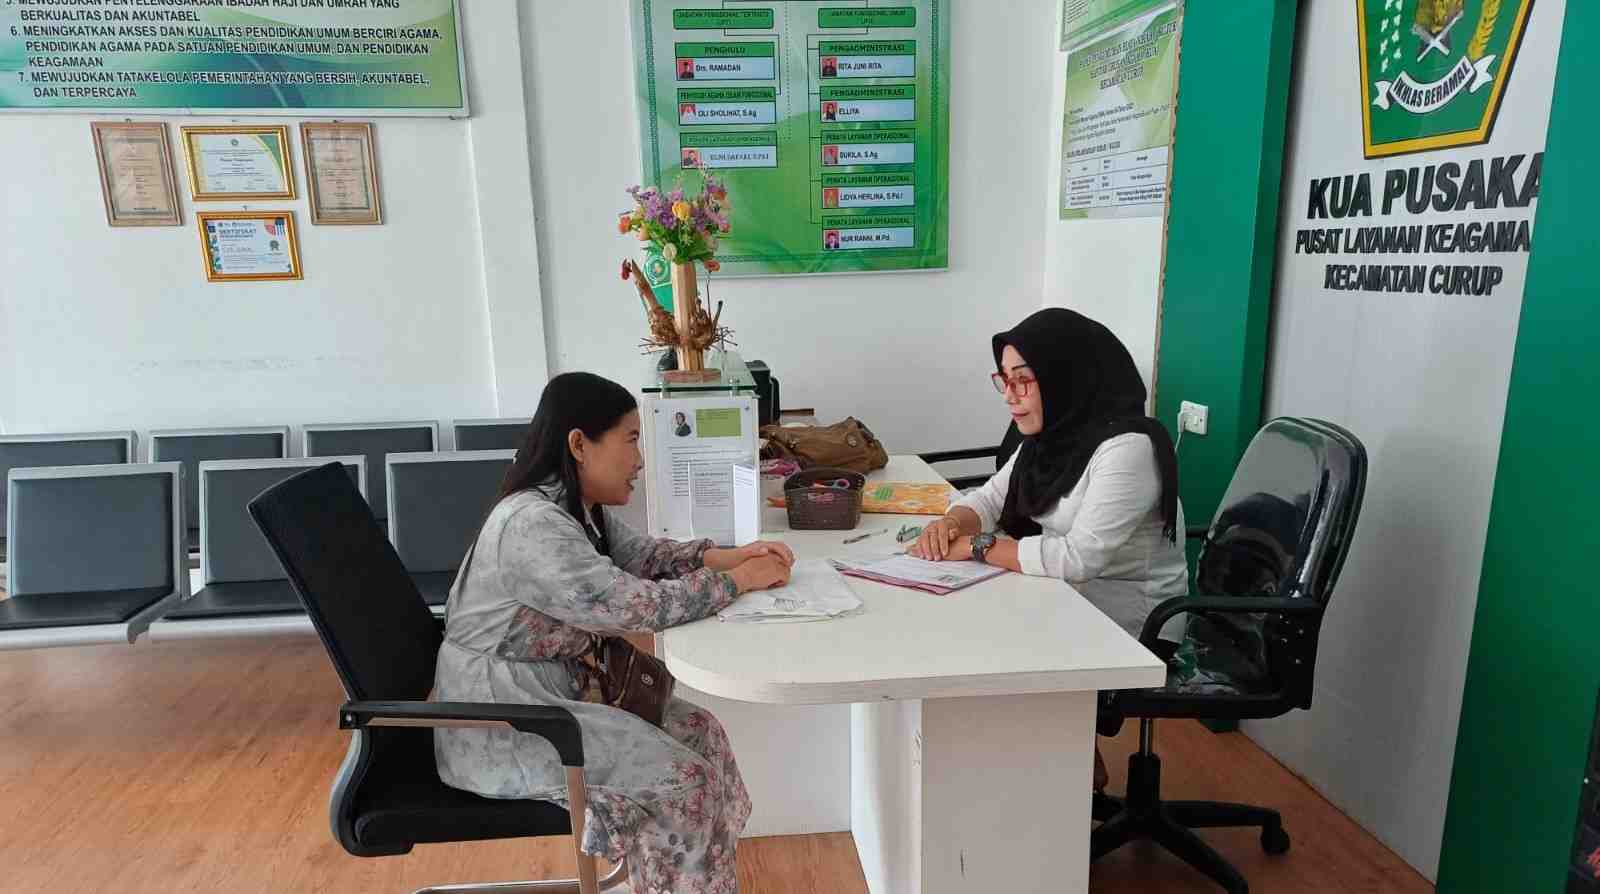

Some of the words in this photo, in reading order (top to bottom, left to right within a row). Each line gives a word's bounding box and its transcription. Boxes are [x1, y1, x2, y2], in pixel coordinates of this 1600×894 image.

[369, 0, 400, 9] YANG
[20, 10, 101, 21] BERKUALITAS
[104, 10, 129, 21] DAN
[132, 10, 200, 21] AKUNTABEL
[10, 26, 21, 36] 6.
[23, 25, 115, 36] MENINGKATKAN
[118, 26, 157, 36] AKSES
[160, 26, 184, 37] DAN
[187, 26, 242, 37] KUALITAS
[245, 26, 316, 38] PENDIDIKAN
[318, 27, 350, 38] UMUM
[353, 28, 397, 39] BERCIRI
[26, 41, 96, 52] PENDIDIKAN
[99, 41, 141, 52] AGAMA
[144, 42, 176, 52] PADA
[178, 42, 223, 52] SATUAN
[226, 42, 294, 53] PENDIDIKAN
[337, 43, 360, 54] DAN
[363, 43, 429, 54] PENDIDIKAN
[704, 46, 746, 55] PENGHULU
[830, 44, 905, 53] PENGADMINISTRASI
[29, 56, 104, 67] KEAGAMAAN
[709, 63, 741, 72] RAMADAN
[18, 71, 29, 82] 7.
[31, 72, 113, 82] MEWUJUDKAN
[116, 72, 190, 83] TATAKELOLA
[192, 72, 280, 83] PEMERINTAHAN
[281, 73, 313, 83] YANG
[1393, 78, 1424, 108] IKHLAS
[1423, 61, 1471, 107] BERAMAL
[33, 87, 58, 97] DAN
[62, 88, 136, 98] TERPERCAYA
[830, 88, 905, 97] PENGADMINISTRASI
[1306, 172, 1373, 220] KUA
[1381, 152, 1546, 216] PUSAKA
[1295, 228, 1344, 254] PUSAT
[1343, 225, 1423, 254] LAYANAN
[1323, 263, 1427, 294] KECAMATAN
[1429, 264, 1504, 296] CURUP
